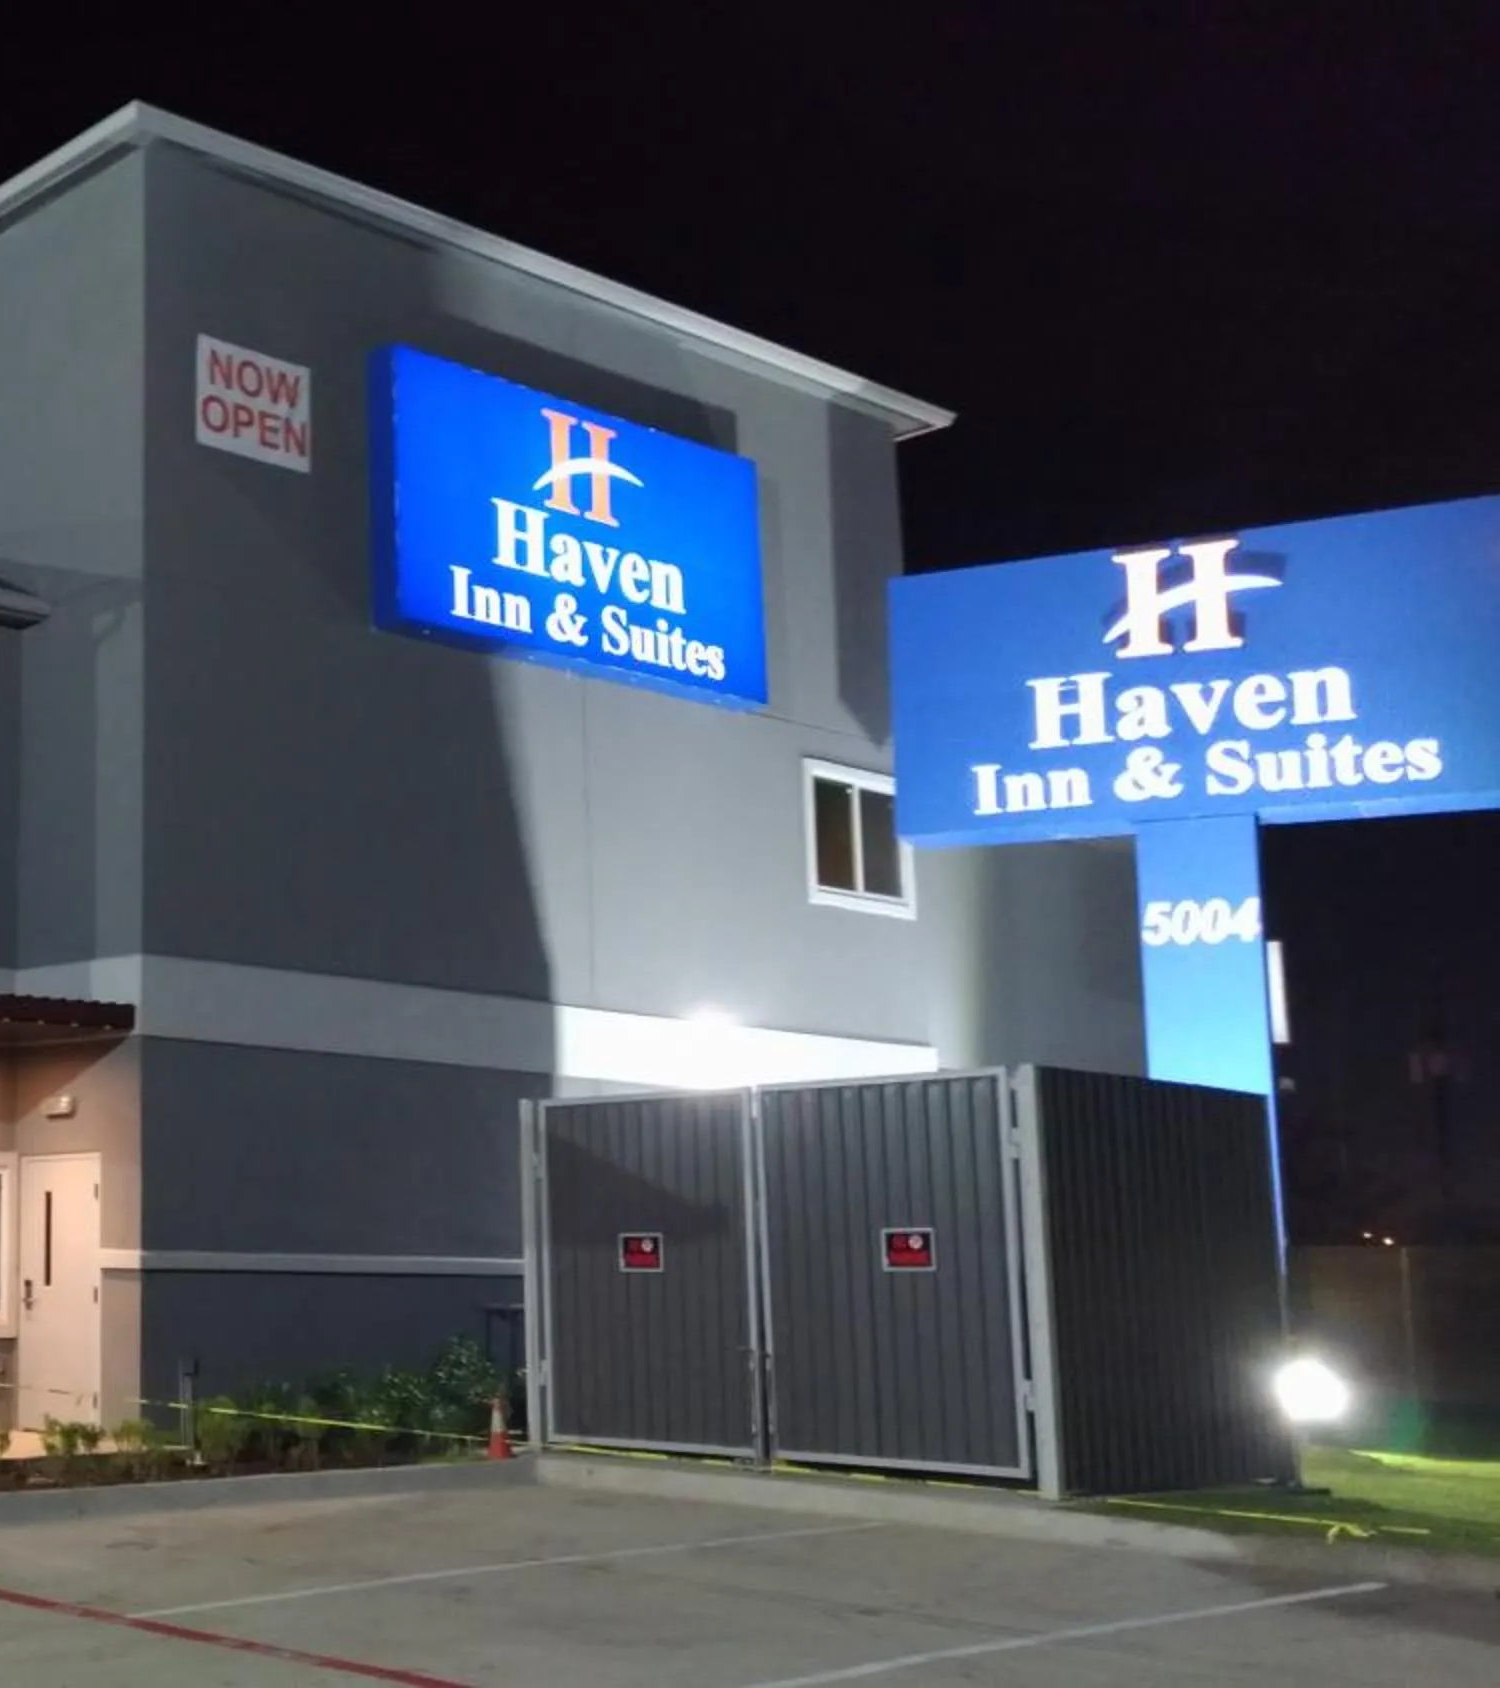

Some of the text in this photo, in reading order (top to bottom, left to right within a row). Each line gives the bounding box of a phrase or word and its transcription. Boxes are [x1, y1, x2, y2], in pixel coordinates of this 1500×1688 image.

[206, 348, 300, 409] NOW
[199, 394, 308, 458] OPEN
[534, 408, 643, 527] H
[491, 498, 685, 614] Haven
[1103, 540, 1282, 658] H
[449, 565, 725, 681] Inn & Suites
[1026, 664, 1357, 750] Haven
[972, 733, 1443, 816] Inn & Suites
[1142, 897, 1262, 945] 5004
